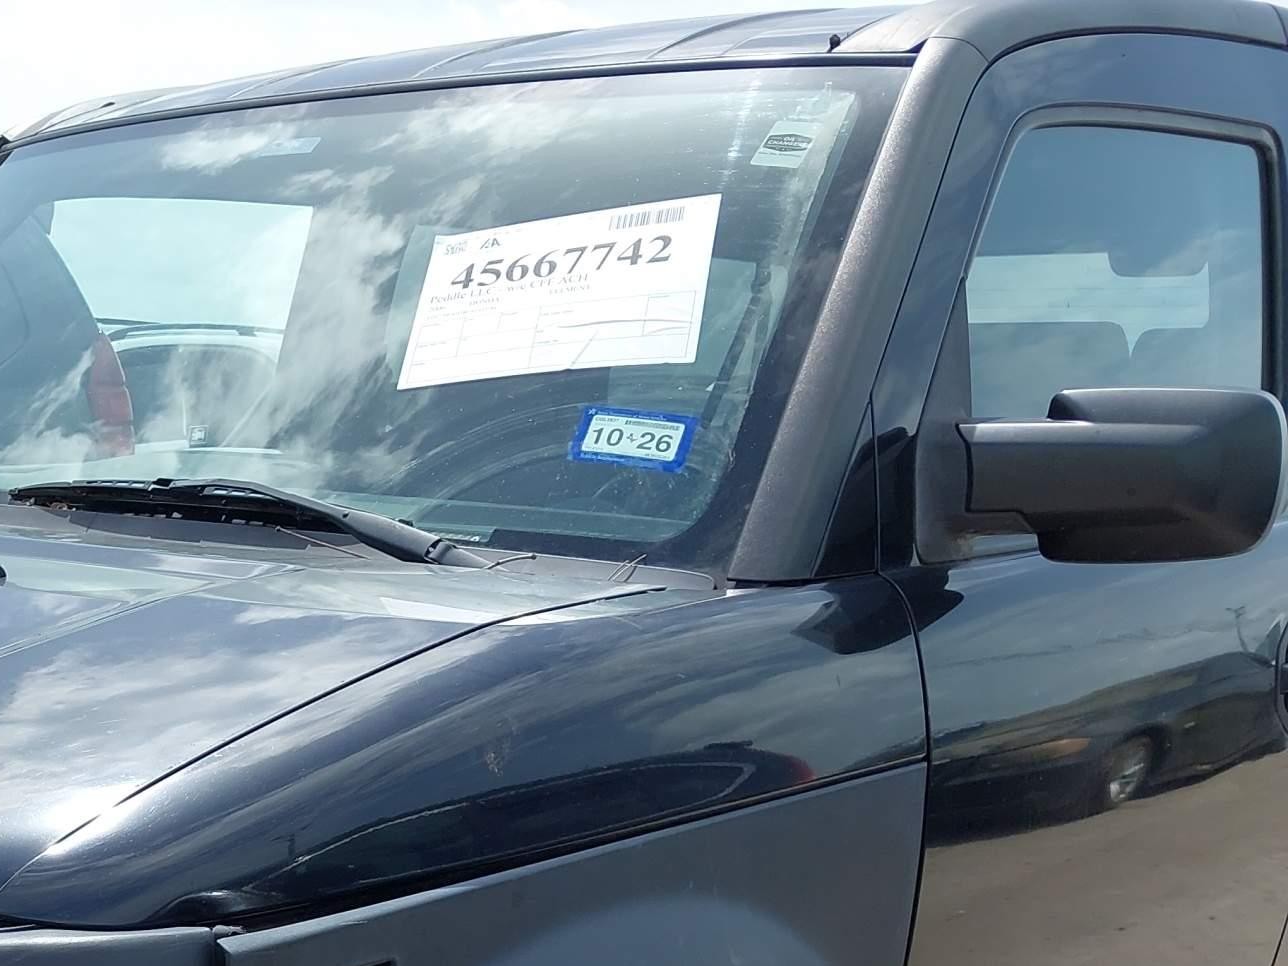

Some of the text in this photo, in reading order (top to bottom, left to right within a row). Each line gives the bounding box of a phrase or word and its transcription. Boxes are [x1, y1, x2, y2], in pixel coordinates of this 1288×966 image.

[450, 234, 673, 290] 45667742
[592, 427, 674, 453] 10 26
